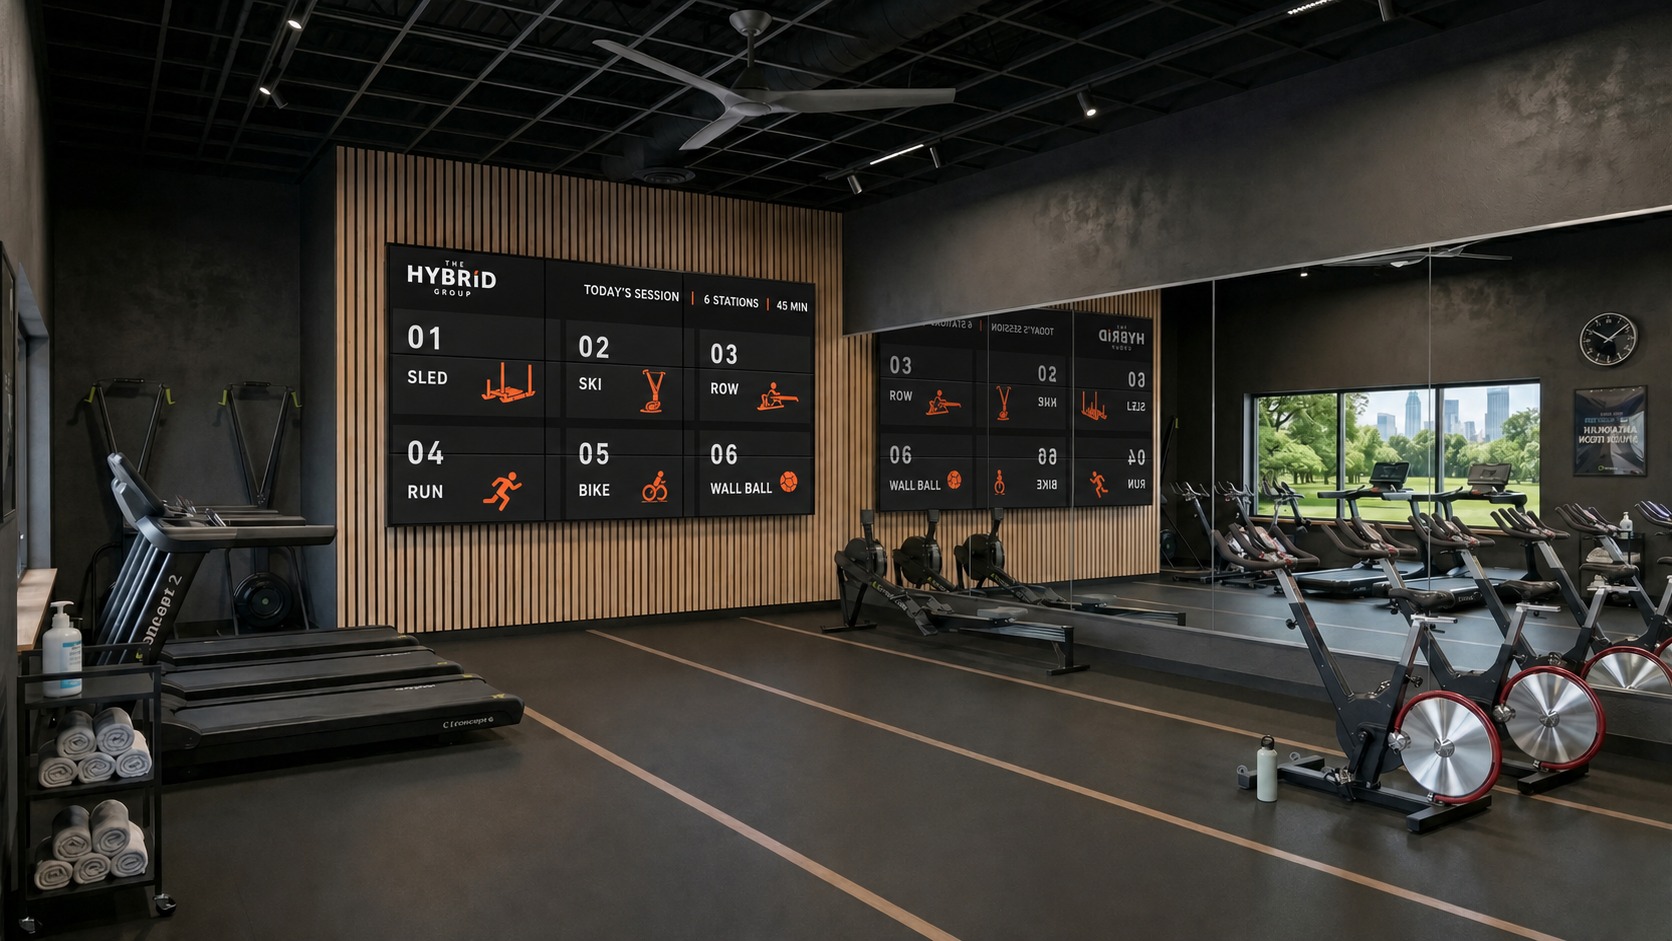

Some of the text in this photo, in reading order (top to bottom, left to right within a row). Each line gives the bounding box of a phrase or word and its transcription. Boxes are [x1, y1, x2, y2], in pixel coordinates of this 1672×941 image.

[445, 260, 464, 268] THE
[433, 288, 472, 298] GROUP
[583, 284, 680, 302] TODAY'S SESSION
[703, 295, 759, 308] 6 STATIONS
[776, 300, 808, 312] 45 MIN
[407, 324, 441, 350] 01
[578, 335, 610, 359] 02
[710, 342, 738, 365] 03
[889, 355, 912, 375] 03
[407, 369, 448, 385] SLED
[578, 376, 602, 391] SKI
[710, 382, 739, 395] ROW
[889, 390, 913, 402] ROW
[407, 440, 444, 465] 04
[578, 442, 610, 465] 05
[710, 443, 738, 465] 06
[889, 445, 912, 465] 06
[407, 484, 443, 499] RUN
[579, 483, 610, 497] BIKE
[710, 482, 773, 495] WALL BALL
[889, 480, 942, 491] WALL BALL
[168, 574, 183, 586] 2
